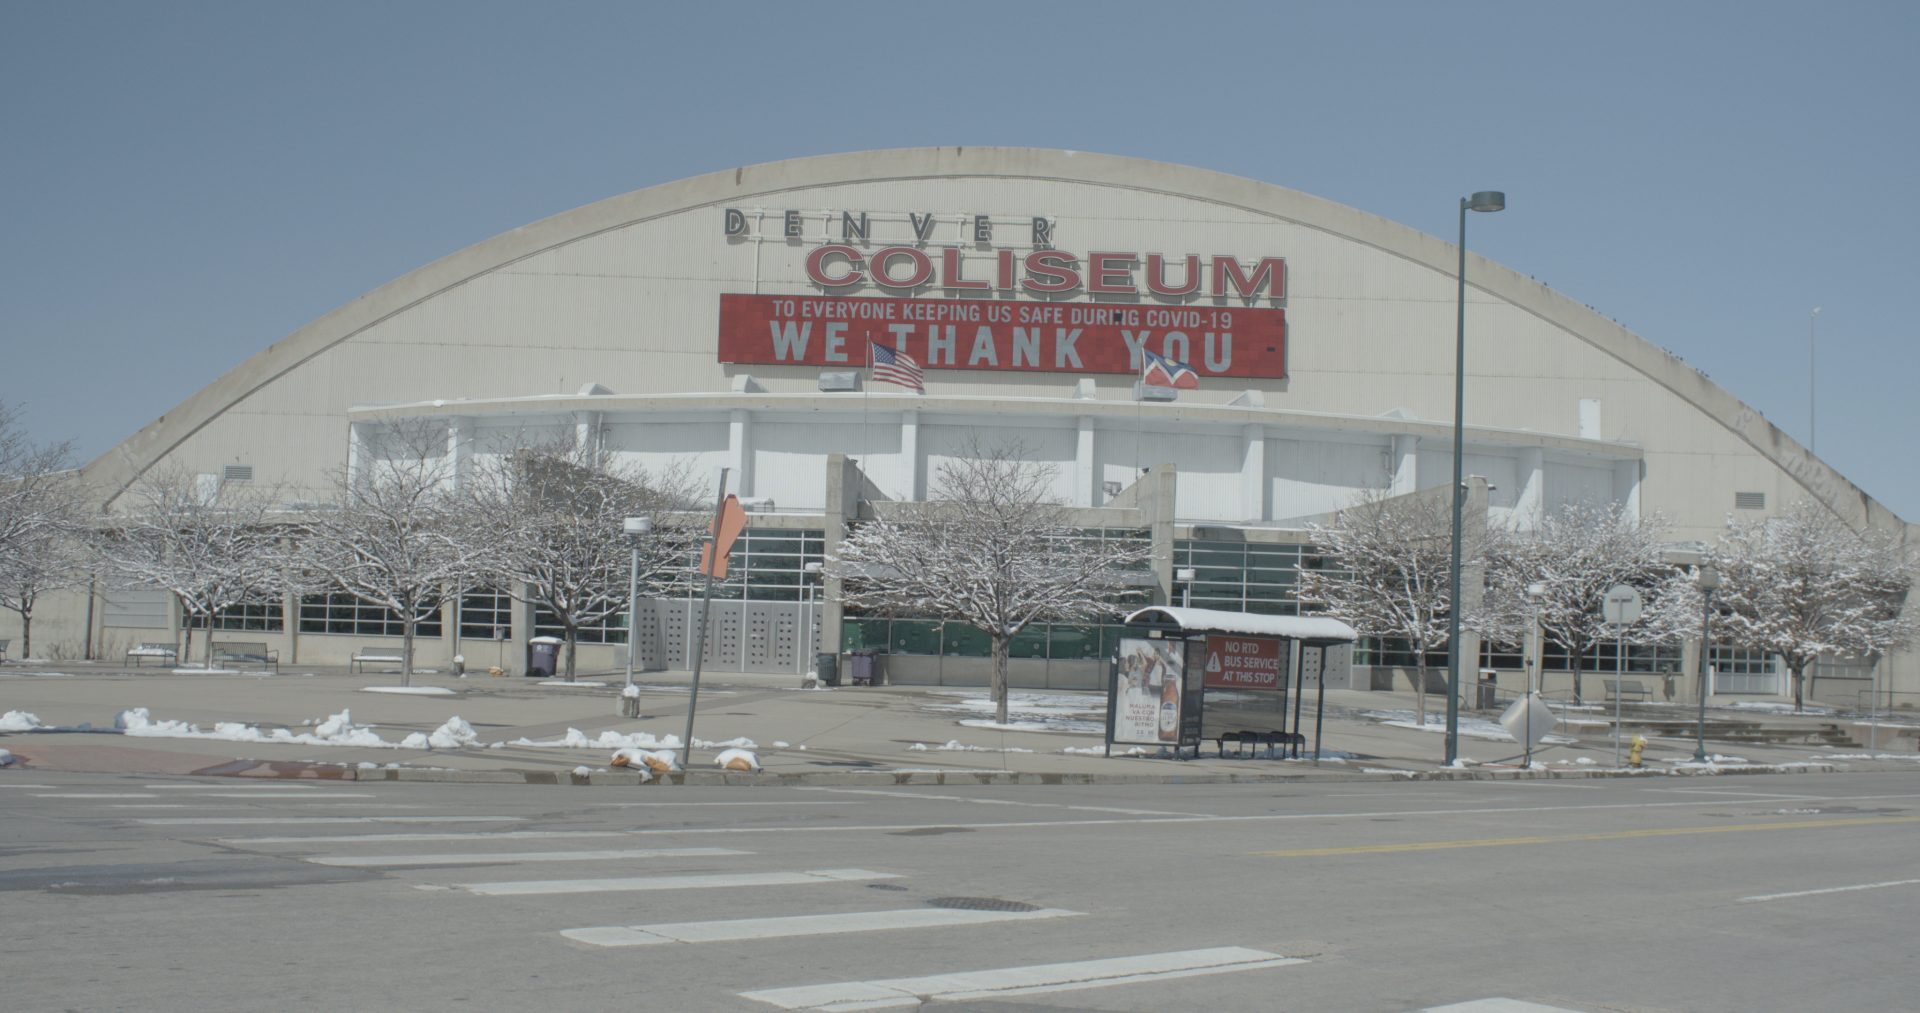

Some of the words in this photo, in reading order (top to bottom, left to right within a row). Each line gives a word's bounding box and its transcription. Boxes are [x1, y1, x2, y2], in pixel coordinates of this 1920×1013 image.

[724, 208, 1051, 244] DENVER
[804, 243, 1287, 298] COLISEUM
[773, 300, 795, 317] TO
[802, 300, 896, 320] EVERYONE
[903, 303, 980, 322] KEEPING
[987, 305, 1012, 323] US
[1019, 306, 1063, 325] SAFE
[1146, 310, 1233, 329] COVID-19
[769, 319, 849, 362] WE
[888, 323, 1084, 369] THANK
[1121, 329, 1232, 373] YOU
[1225, 641, 1240, 653] NO
[1242, 642, 1259, 654] RTD
[1222, 670, 1234, 681] AT
[1235, 671, 1254, 682] THIS
[1254, 672, 1275, 684] STOP
[1224, 655, 1242, 668] BUS
[1243, 656, 1279, 670] SERVICE
